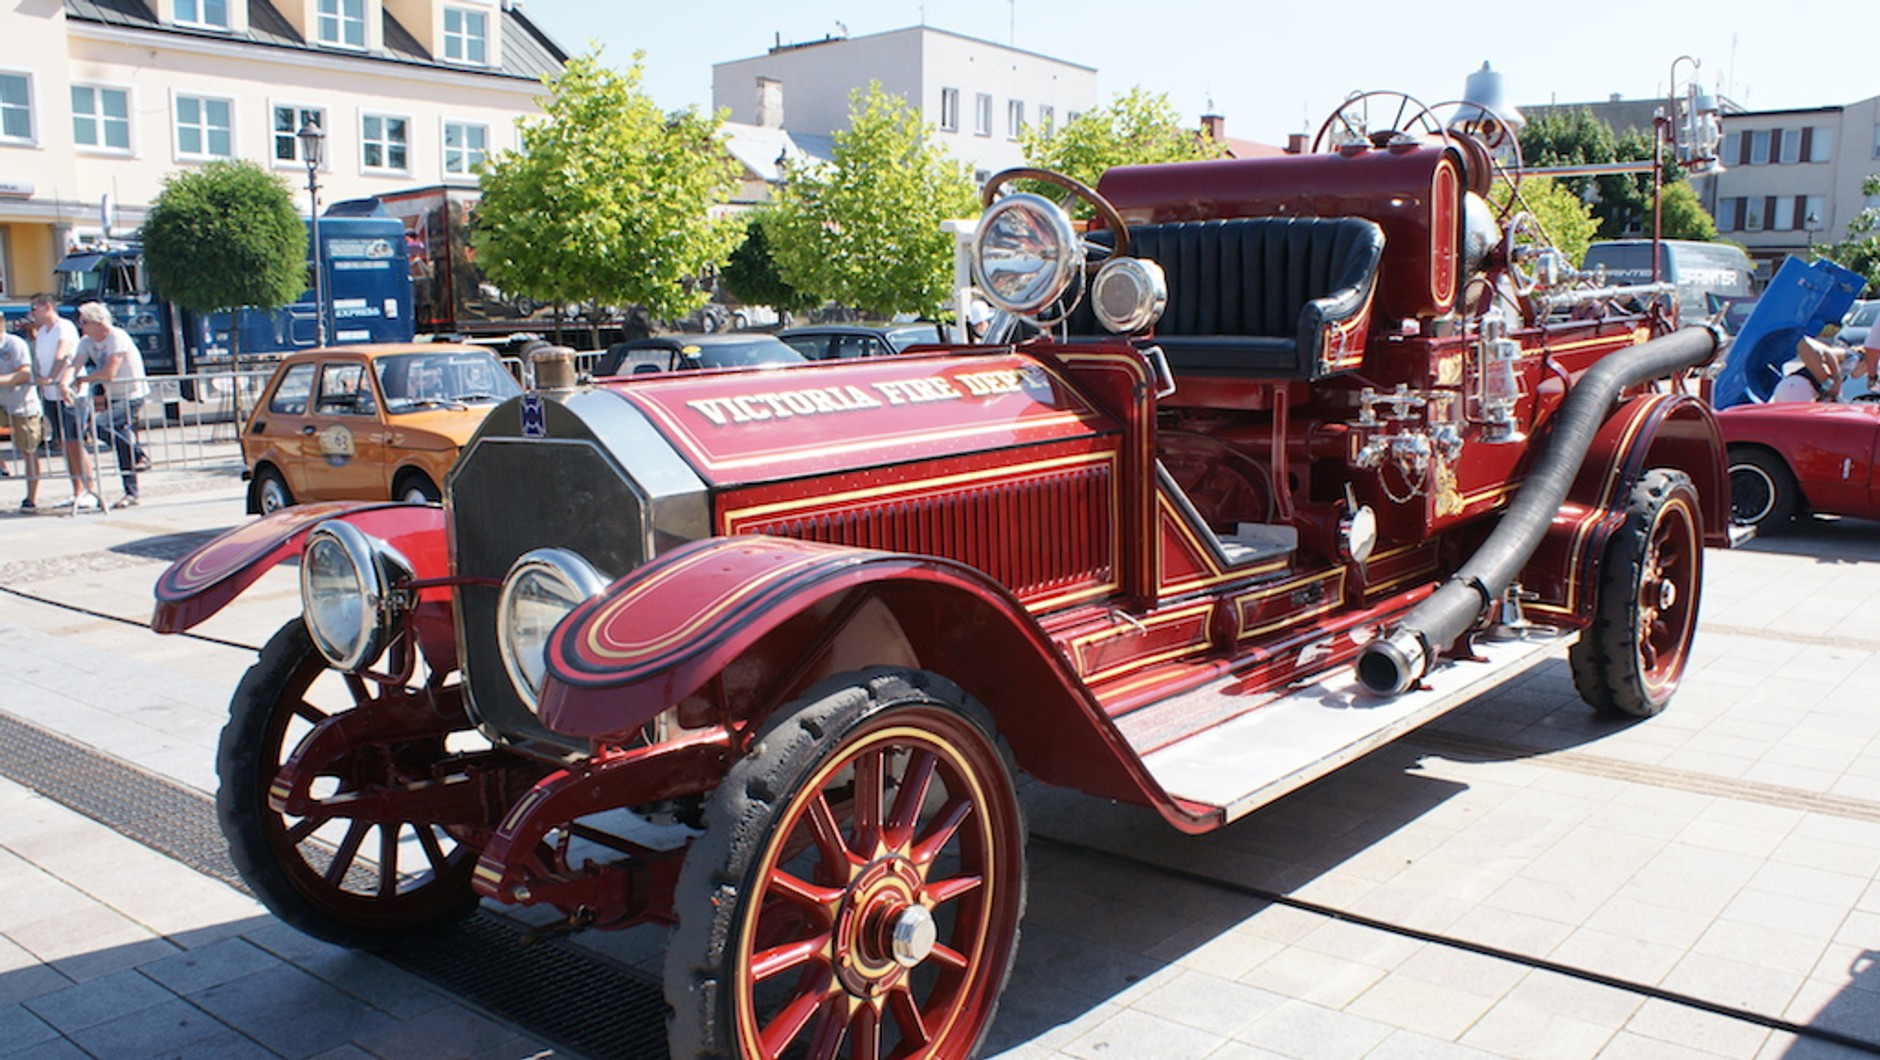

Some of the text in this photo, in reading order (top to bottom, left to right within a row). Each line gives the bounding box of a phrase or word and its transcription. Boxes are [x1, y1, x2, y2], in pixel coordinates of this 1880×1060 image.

[1676, 267, 1737, 286] SPRINTER
[685, 386, 882, 425] VICTORIA
[870, 376, 963, 406] FIRE
